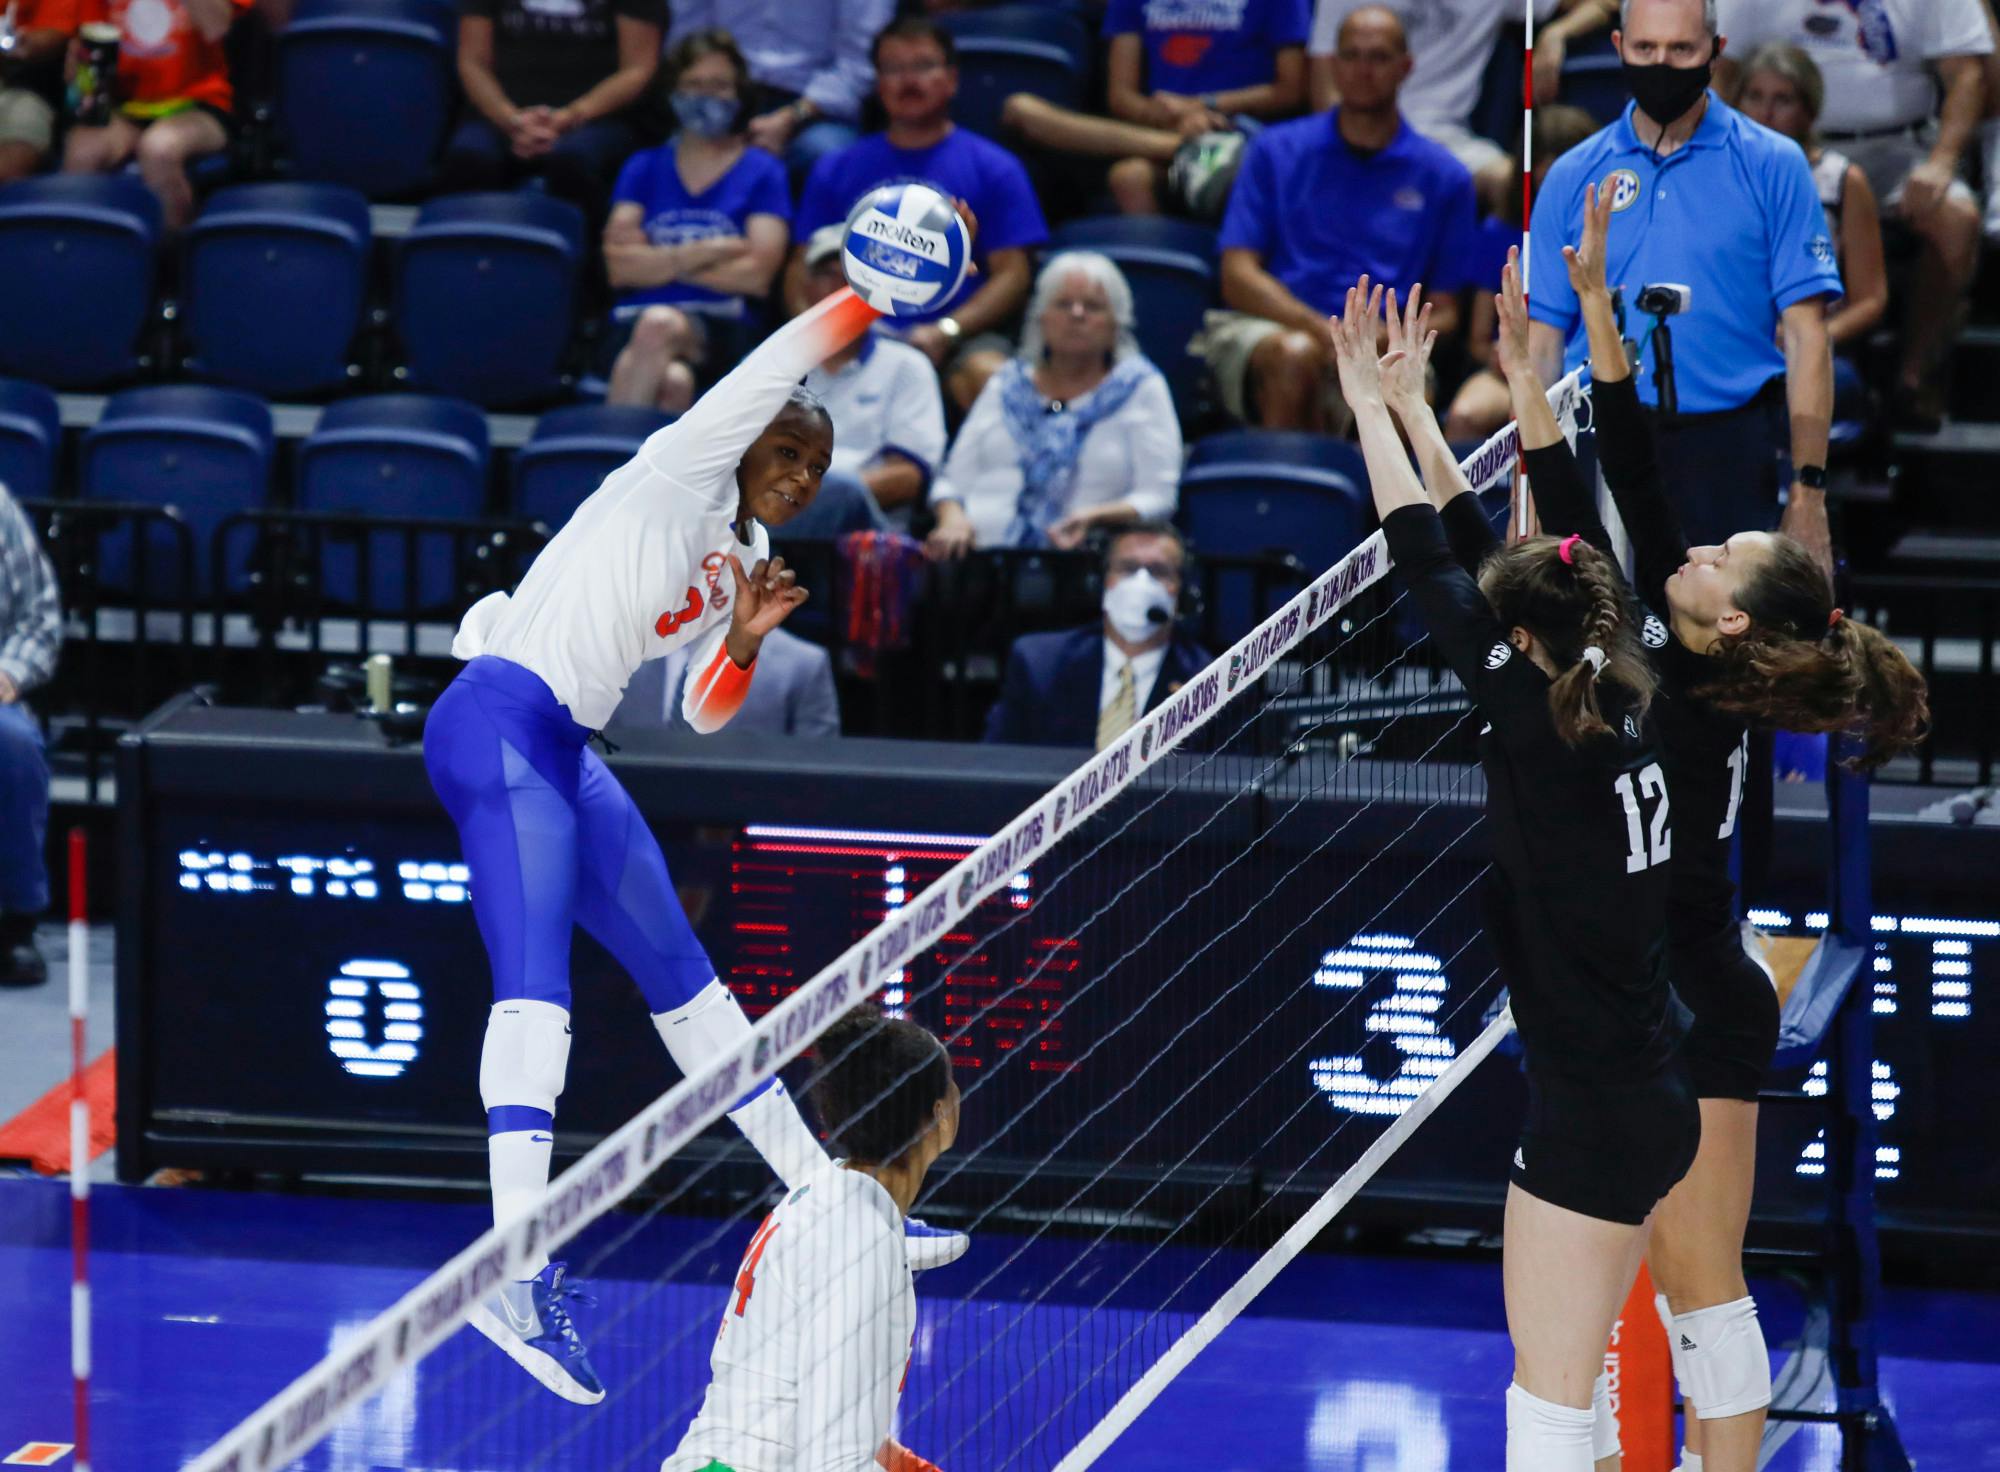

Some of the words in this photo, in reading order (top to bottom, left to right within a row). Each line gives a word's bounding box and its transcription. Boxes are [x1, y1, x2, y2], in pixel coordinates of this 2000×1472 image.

[866, 220, 935, 256] molten
[655, 586, 704, 639] 3
[1614, 761, 1671, 874] 12
[324, 957, 424, 1078] 0
[1308, 932, 1456, 1116] 3
